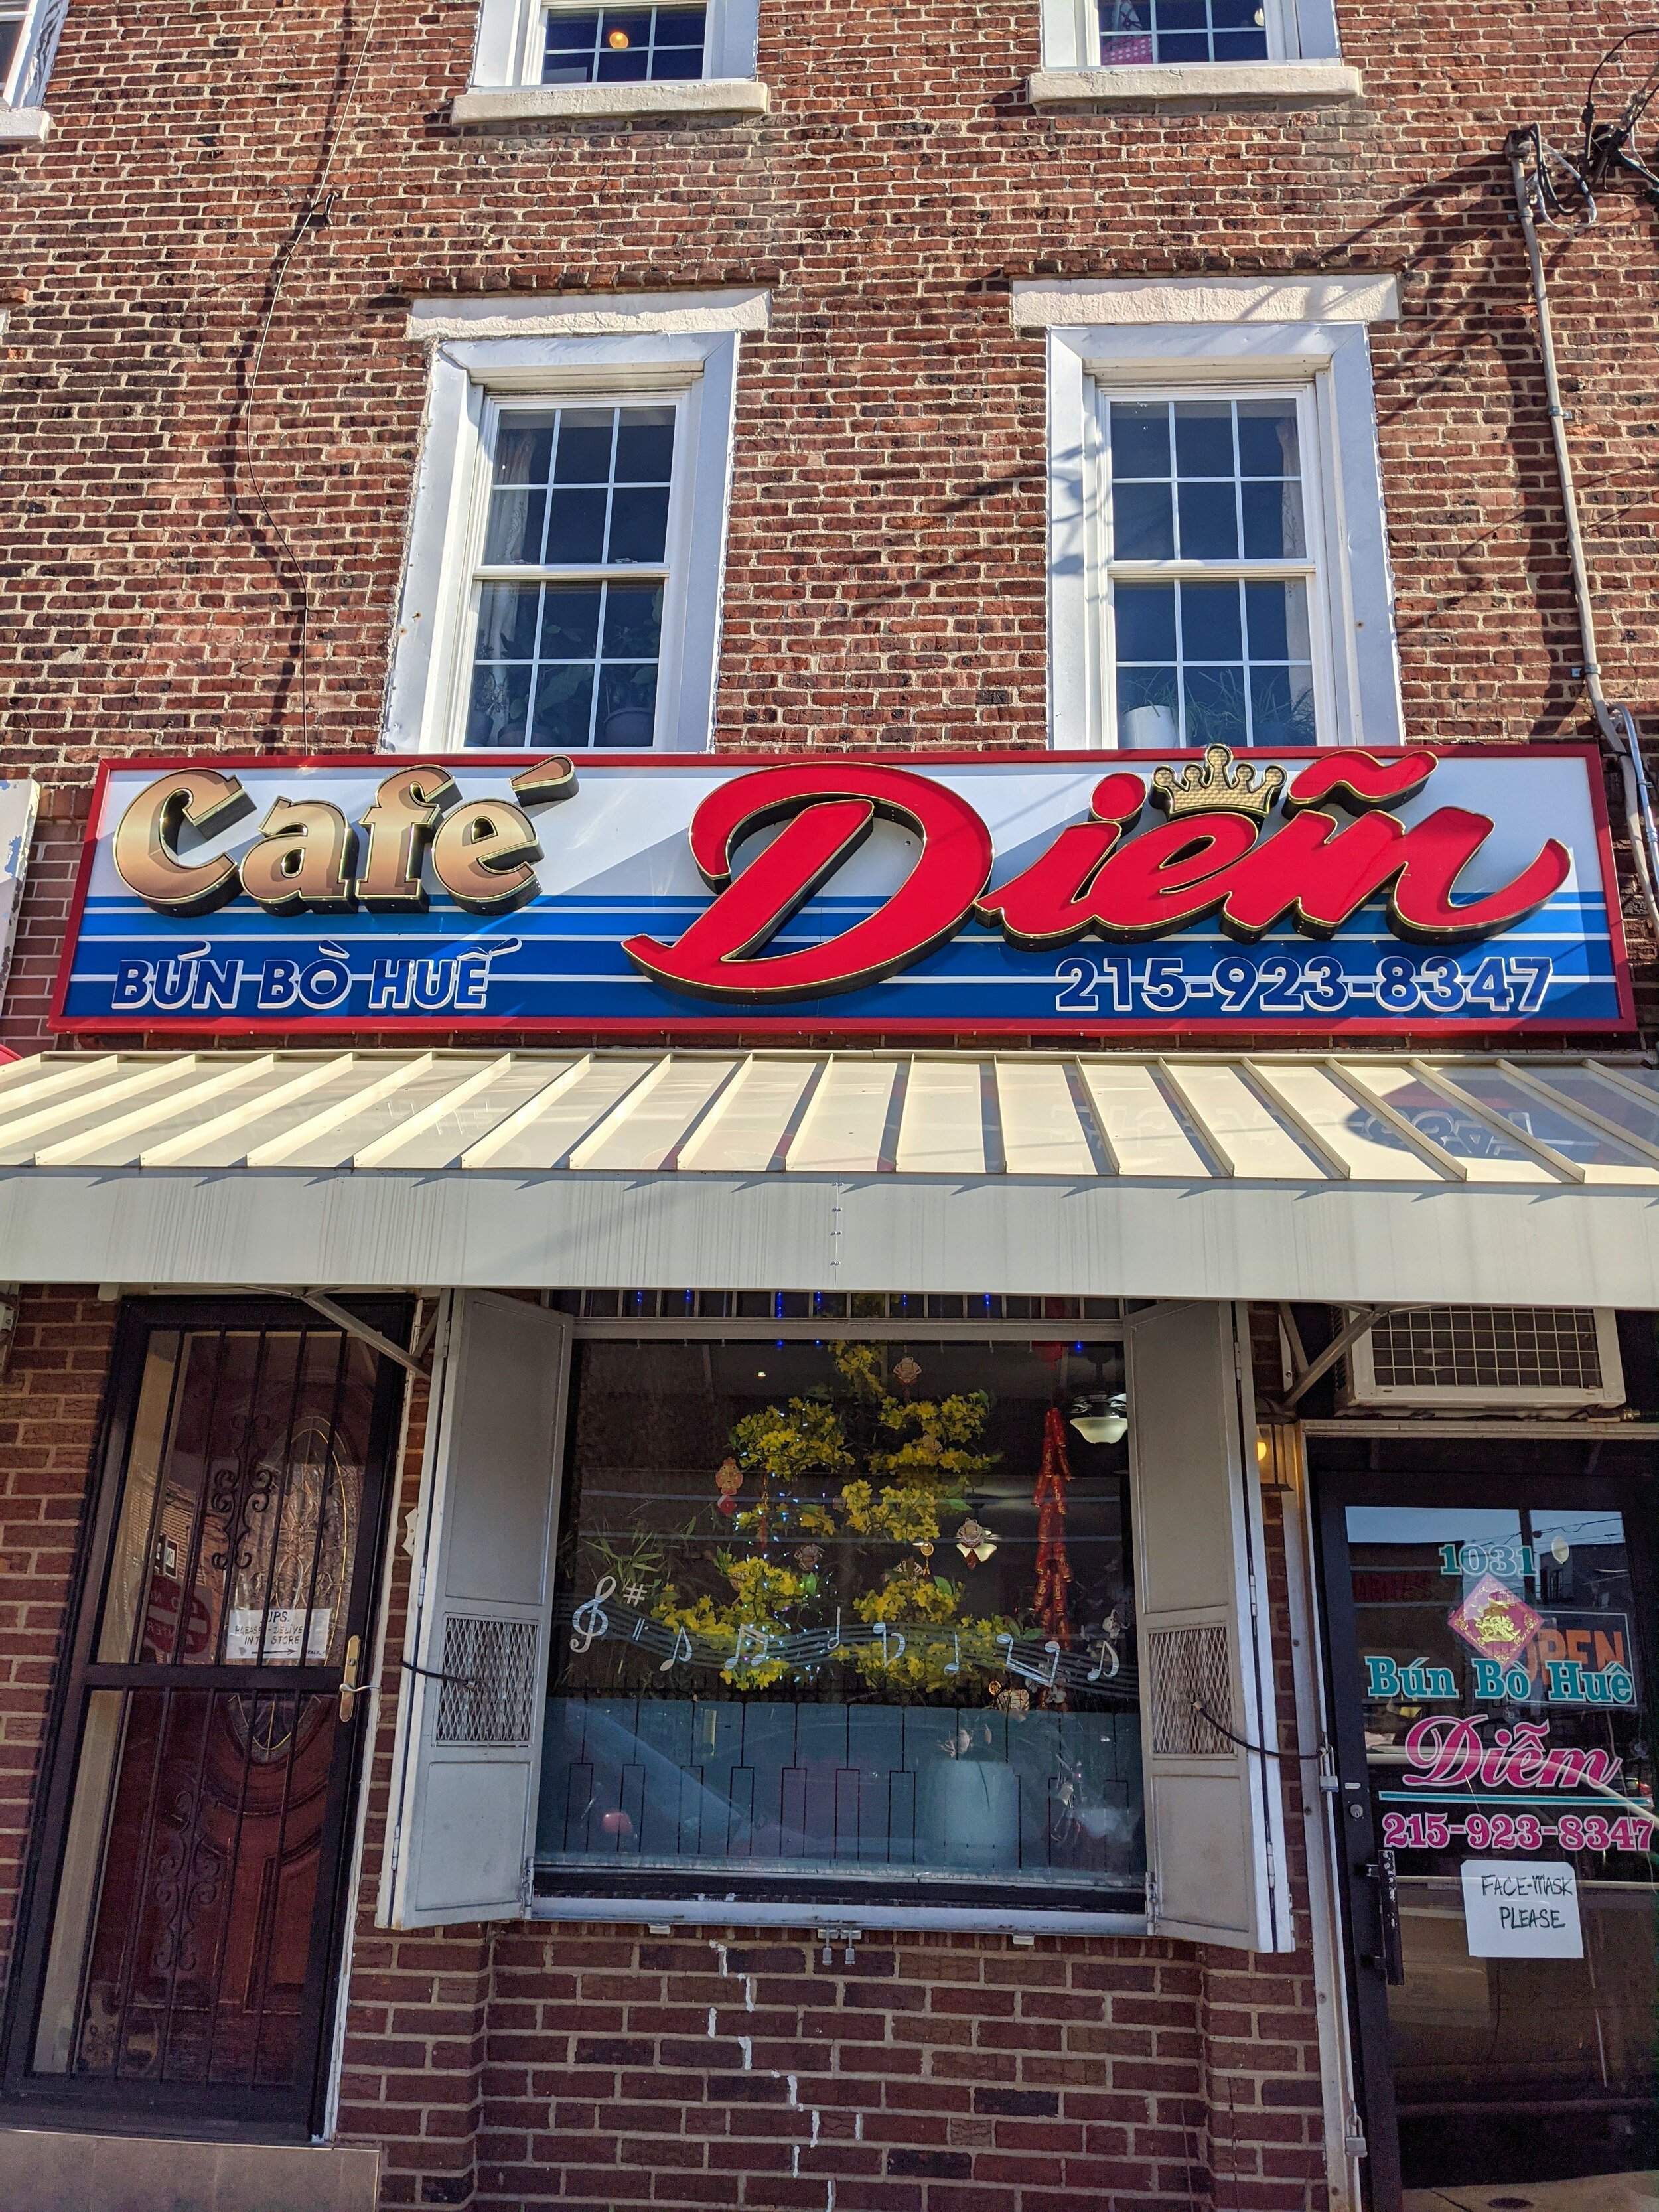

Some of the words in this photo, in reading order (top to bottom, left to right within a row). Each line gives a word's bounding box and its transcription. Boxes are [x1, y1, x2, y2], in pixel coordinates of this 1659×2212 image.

[114, 755, 579, 915] Café
[111, 941, 241, 1010] BÚN
[257, 939, 352, 1010] BÒ
[369, 937, 522, 1010] HUẾ
[1055, 956, 1553, 1012] 215-923-8347
[1439, 1544, 1536, 1576] 1031
[1364, 1655, 1459, 1698] Bún
[1471, 1657, 1531, 1700] Bò
[1402, 1714, 1623, 1787] Diễm
[1382, 1812, 1654, 1851] 215-923-8347
[1500, 1906, 1566, 1930] PLEASE
